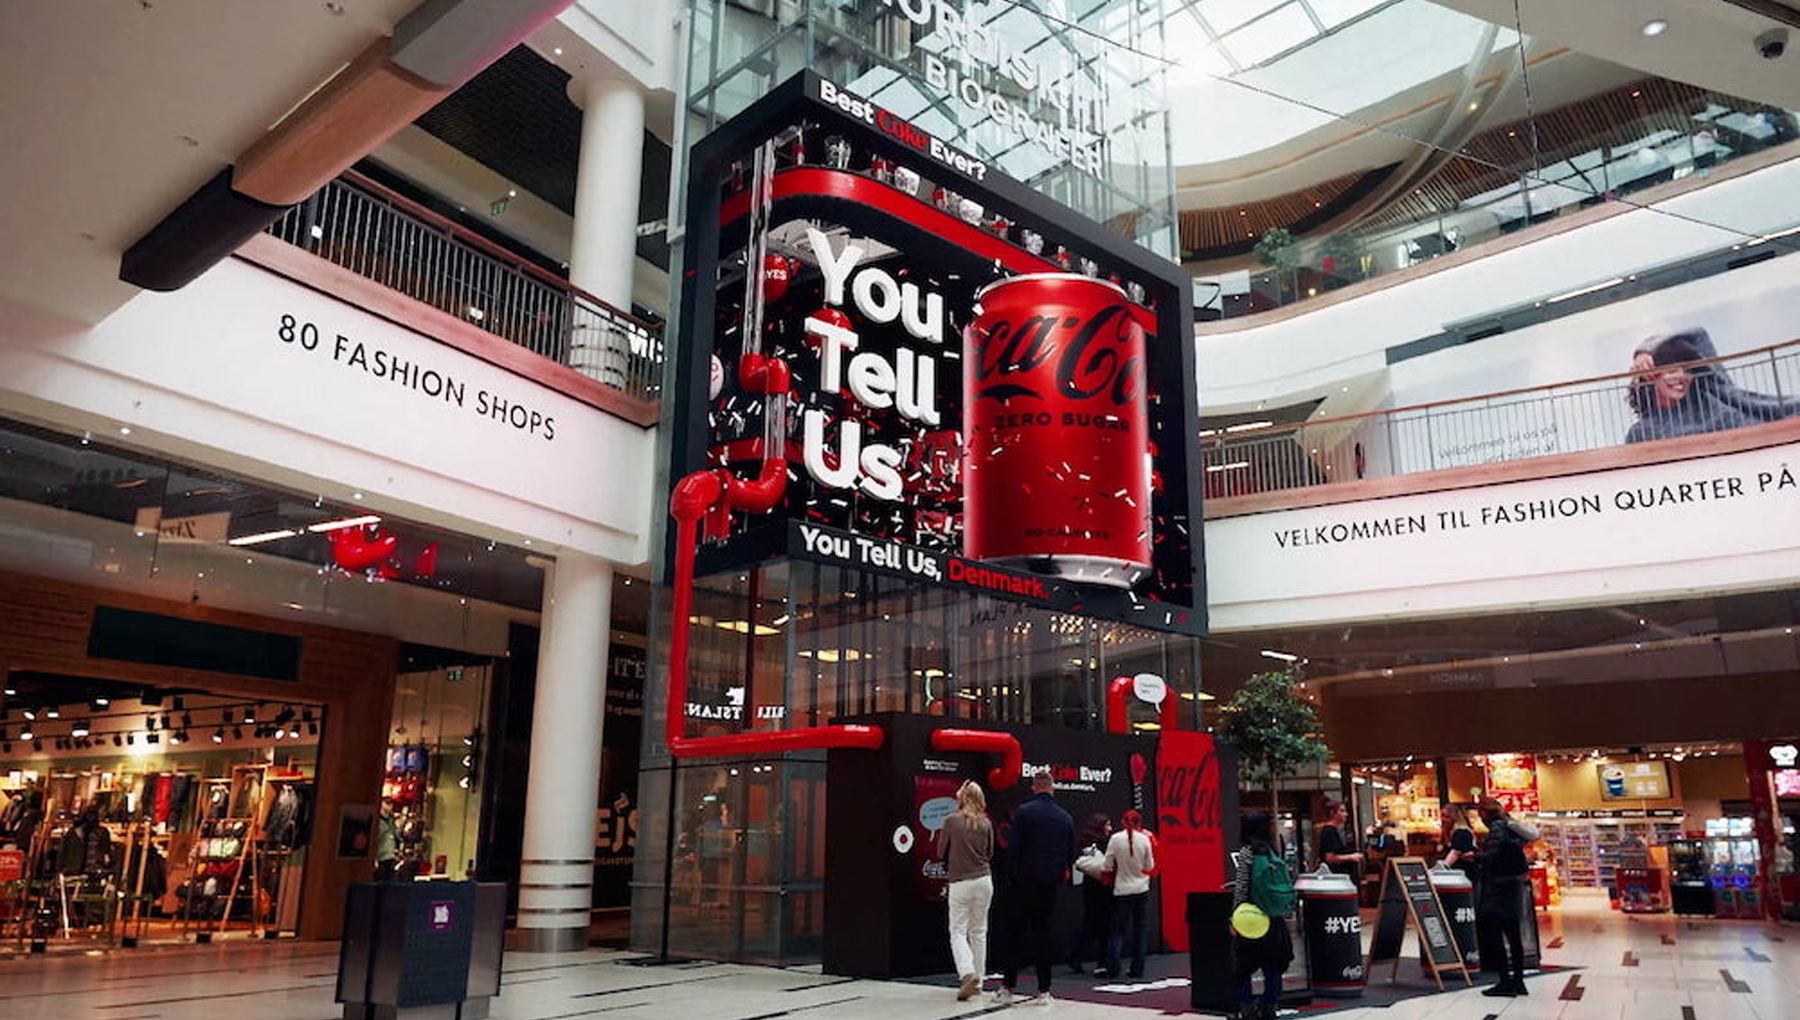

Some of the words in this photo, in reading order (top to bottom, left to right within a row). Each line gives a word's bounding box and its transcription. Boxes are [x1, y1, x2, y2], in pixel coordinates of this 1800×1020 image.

[821, 79, 874, 124] Best
[877, 109, 930, 151] Coke
[930, 137, 988, 181] Ever?
[767, 268, 787, 281] YES
[807, 228, 944, 344] You
[278, 313, 320, 351] 80
[333, 334, 466, 408] FASHION
[476, 390, 556, 441] SHOPS
[804, 316, 941, 427] Tell
[804, 409, 905, 502] Us
[994, 411, 1053, 430] ZERO
[1274, 514, 1427, 549] VELKOMMEN
[1437, 511, 1471, 531] TIL
[1481, 494, 1602, 526] FASHION
[1614, 476, 1744, 511] QUARTER
[1758, 463, 1797, 493] PÅ
[800, 525, 850, 560] You
[857, 537, 902, 570] Tell
[907, 549, 942, 582] Us,
[947, 558, 1051, 600] Denmark.
[1080, 765, 1112, 783] Ever?
